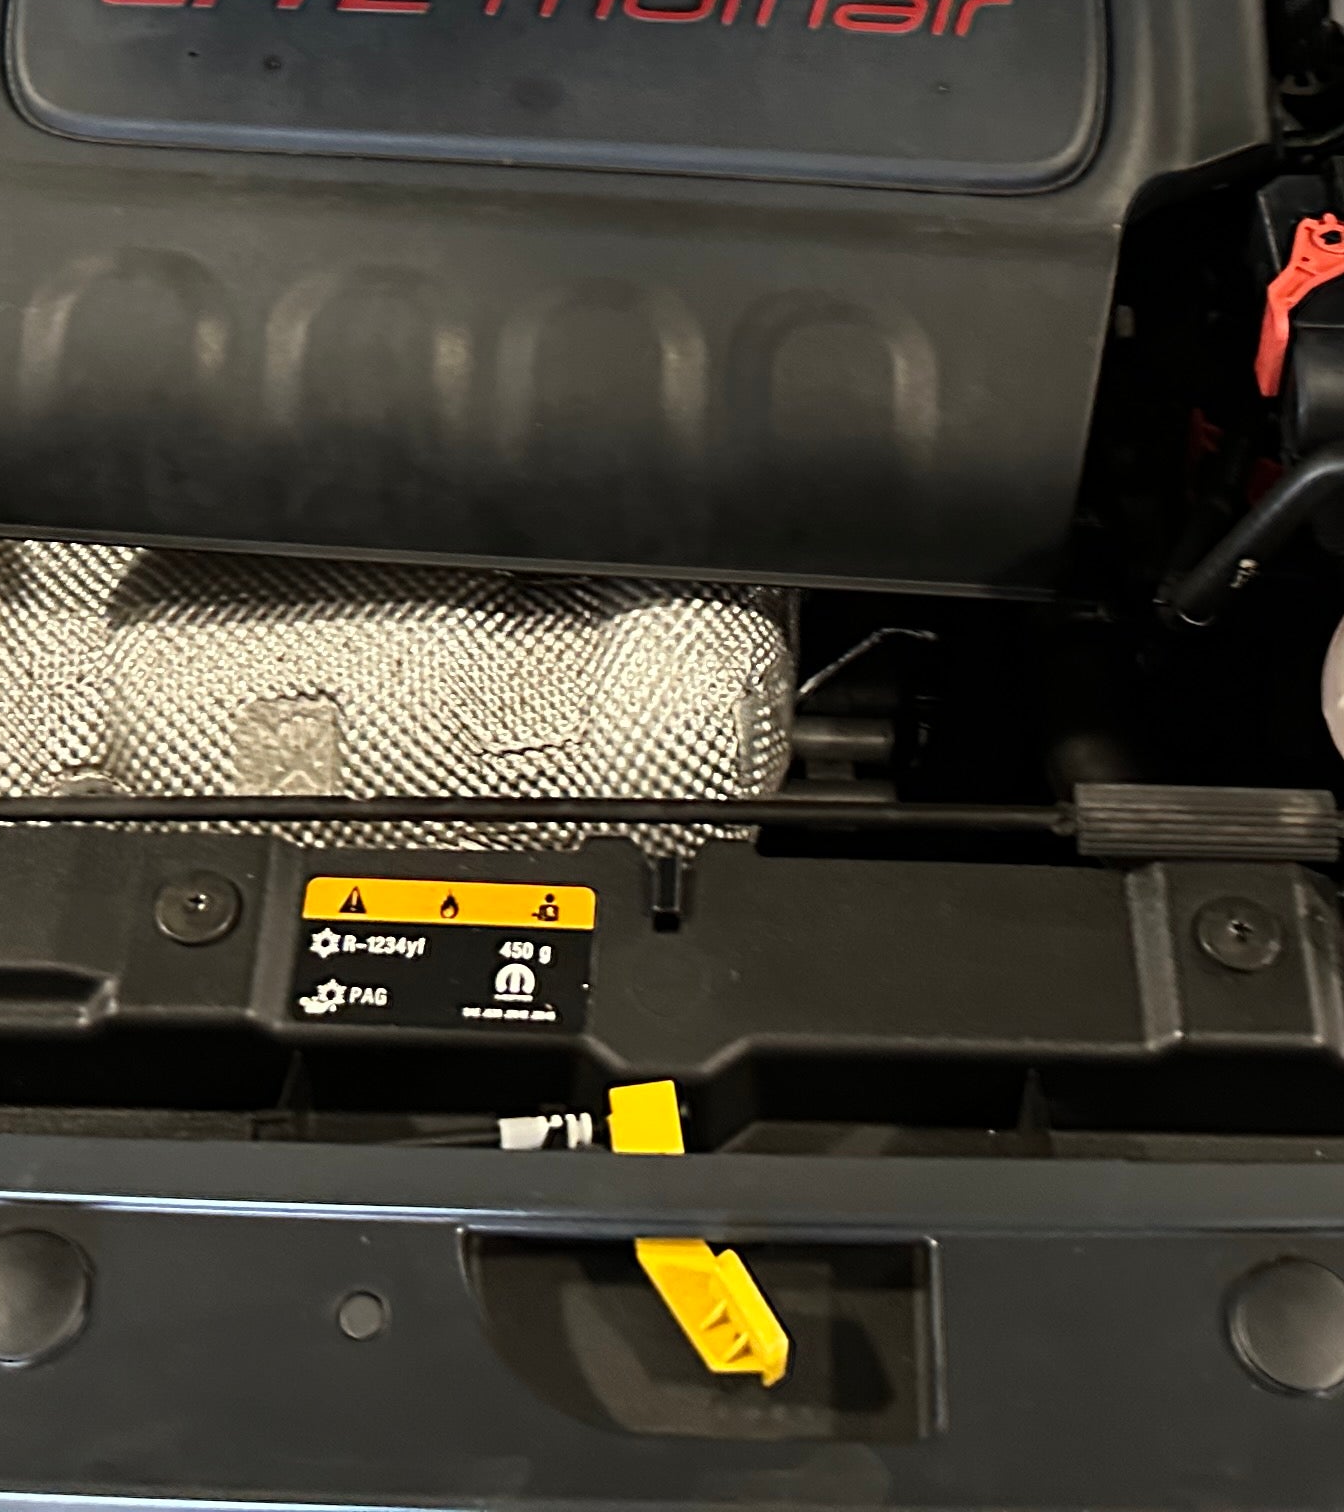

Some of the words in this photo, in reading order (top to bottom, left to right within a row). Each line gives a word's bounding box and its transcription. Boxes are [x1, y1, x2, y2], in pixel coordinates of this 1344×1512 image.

[343, 935, 426, 959] R-1234yf
[499, 941, 534, 960] 450
[538, 945, 552, 964] g
[349, 986, 388, 1006] PAG
